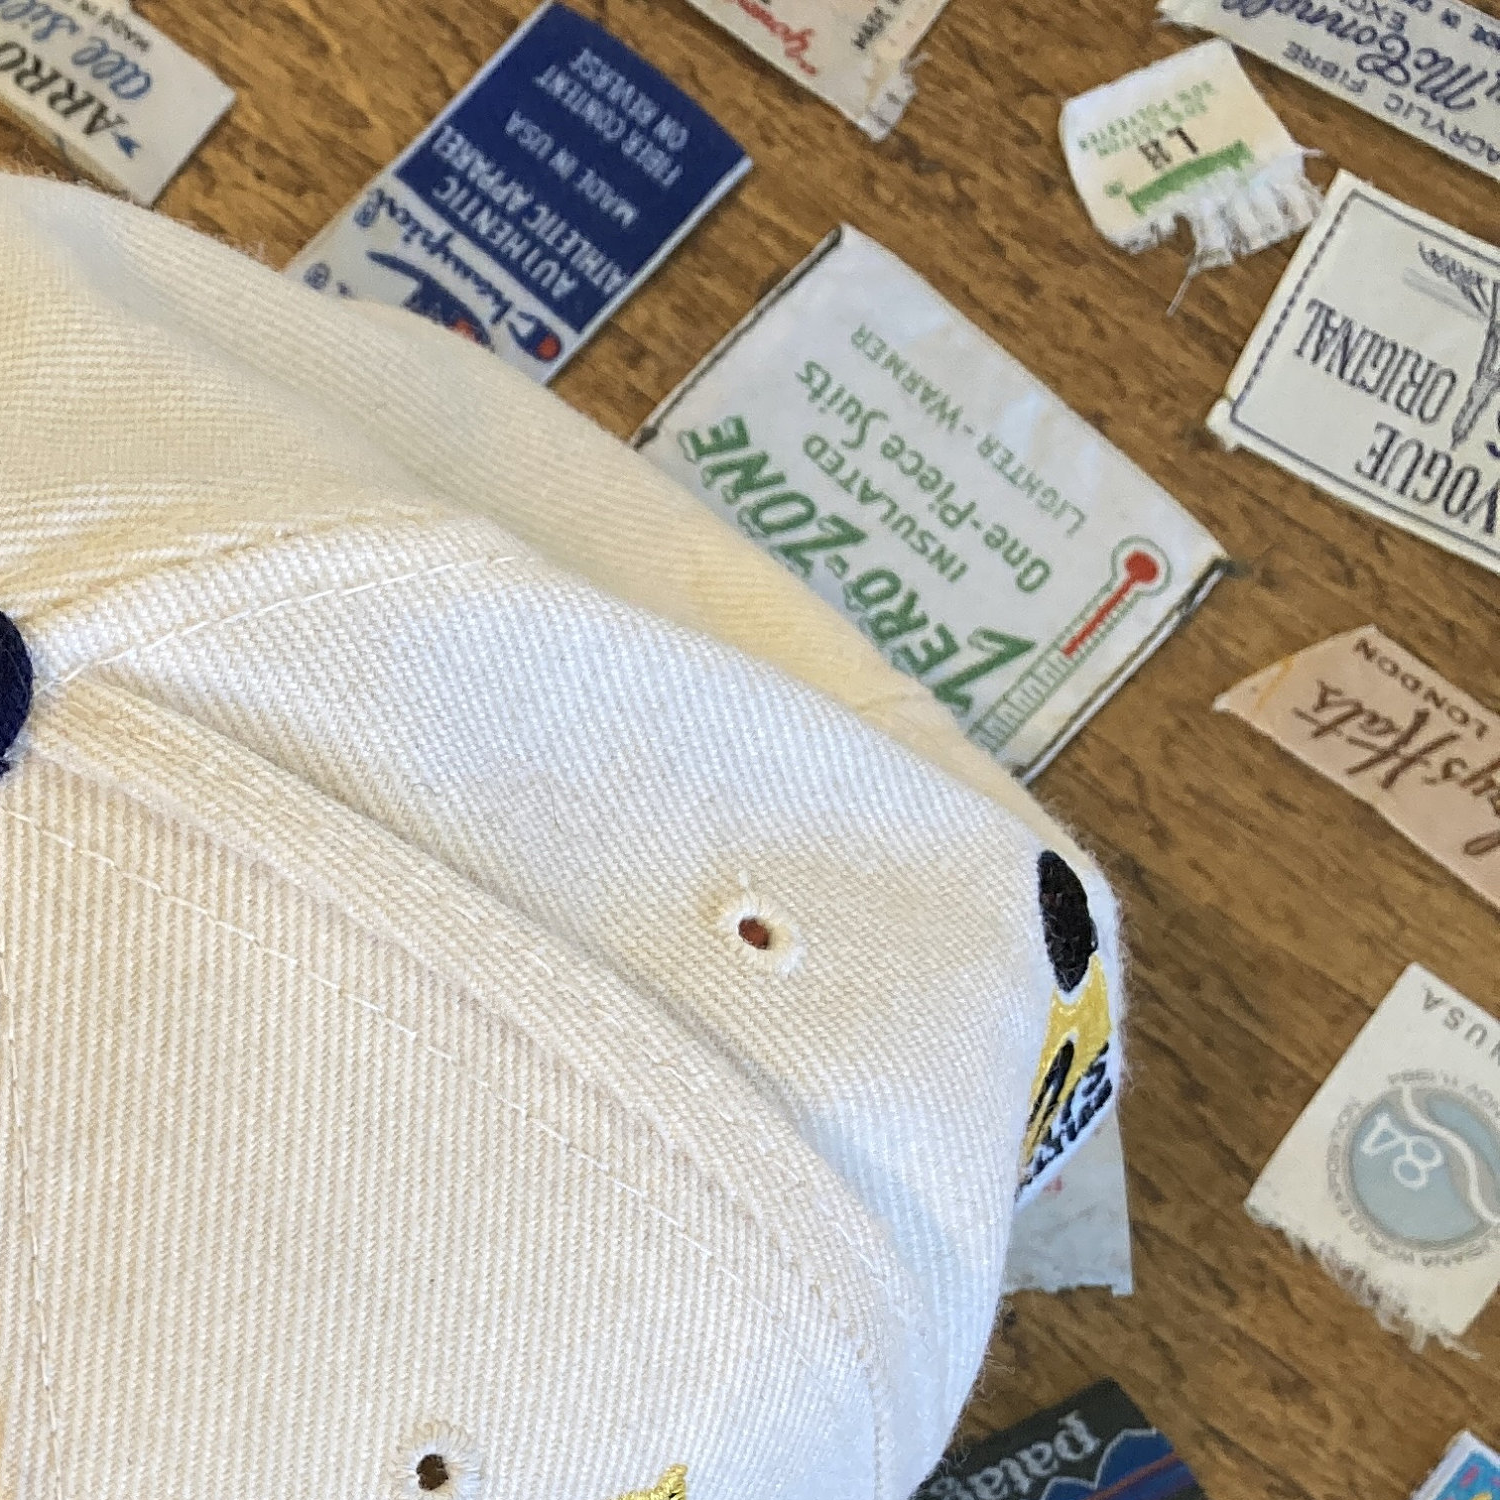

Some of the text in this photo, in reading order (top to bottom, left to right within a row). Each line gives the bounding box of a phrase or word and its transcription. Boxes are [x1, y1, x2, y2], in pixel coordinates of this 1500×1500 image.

[532, 61, 682, 188] FIBER CONTENT
[565, 46, 691, 154] ON REVERSE
[1280, 38, 1500, 167] ACRYLIC FIBRE
[428, 122, 629, 296] ATHLETIC APPAREL
[498, 107, 641, 228] MADE IN USA
[429, 170, 579, 303] AUTHENTIC
[1282, 296, 1461, 429] ORIGINAL
[781, 350, 1057, 600] One-Piece Suits
[843, 317, 1090, 539] LIGHTER WARMER
[1351, 419, 1498, 535] VOGUE
[678, 416, 1036, 723] ZERO-ZONE
[797, 428, 970, 587] INSULATED
[1291, 678, 1461, 790] Hats
[1350, 635, 1490, 740] LONDON
[1350, 1107, 1451, 1198] 84
